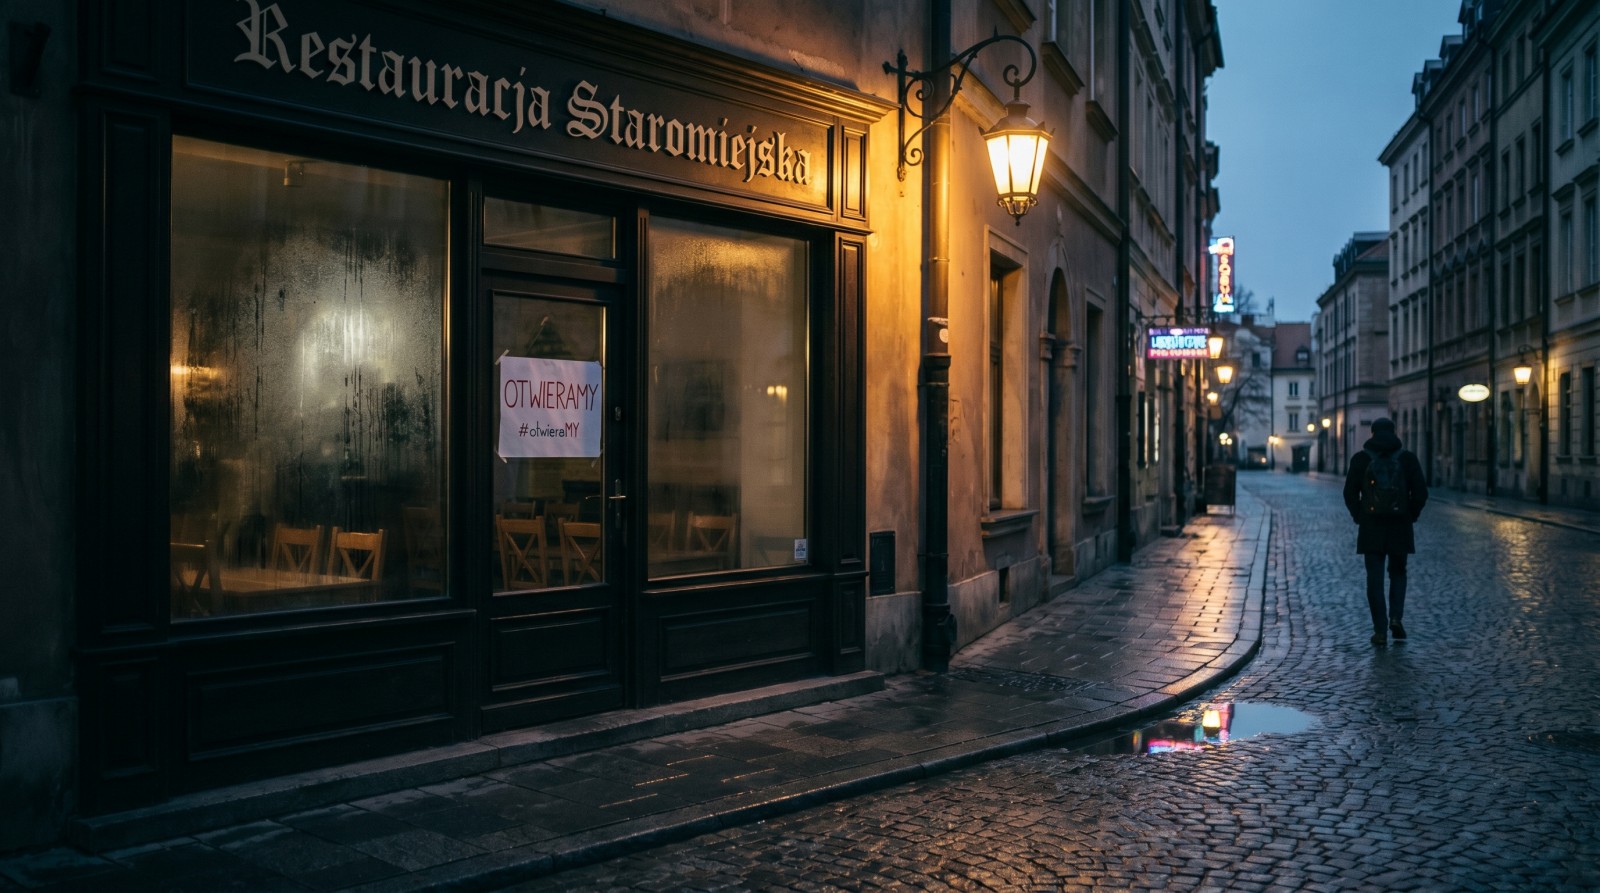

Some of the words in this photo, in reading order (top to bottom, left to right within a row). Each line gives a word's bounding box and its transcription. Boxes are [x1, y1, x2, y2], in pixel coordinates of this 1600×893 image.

[234, 0, 552, 134] Restauracja
[566, 80, 812, 185] Staromiejska
[504, 379, 599, 411] OTWIERAMY
[519, 420, 580, 438] #otwieraMY
